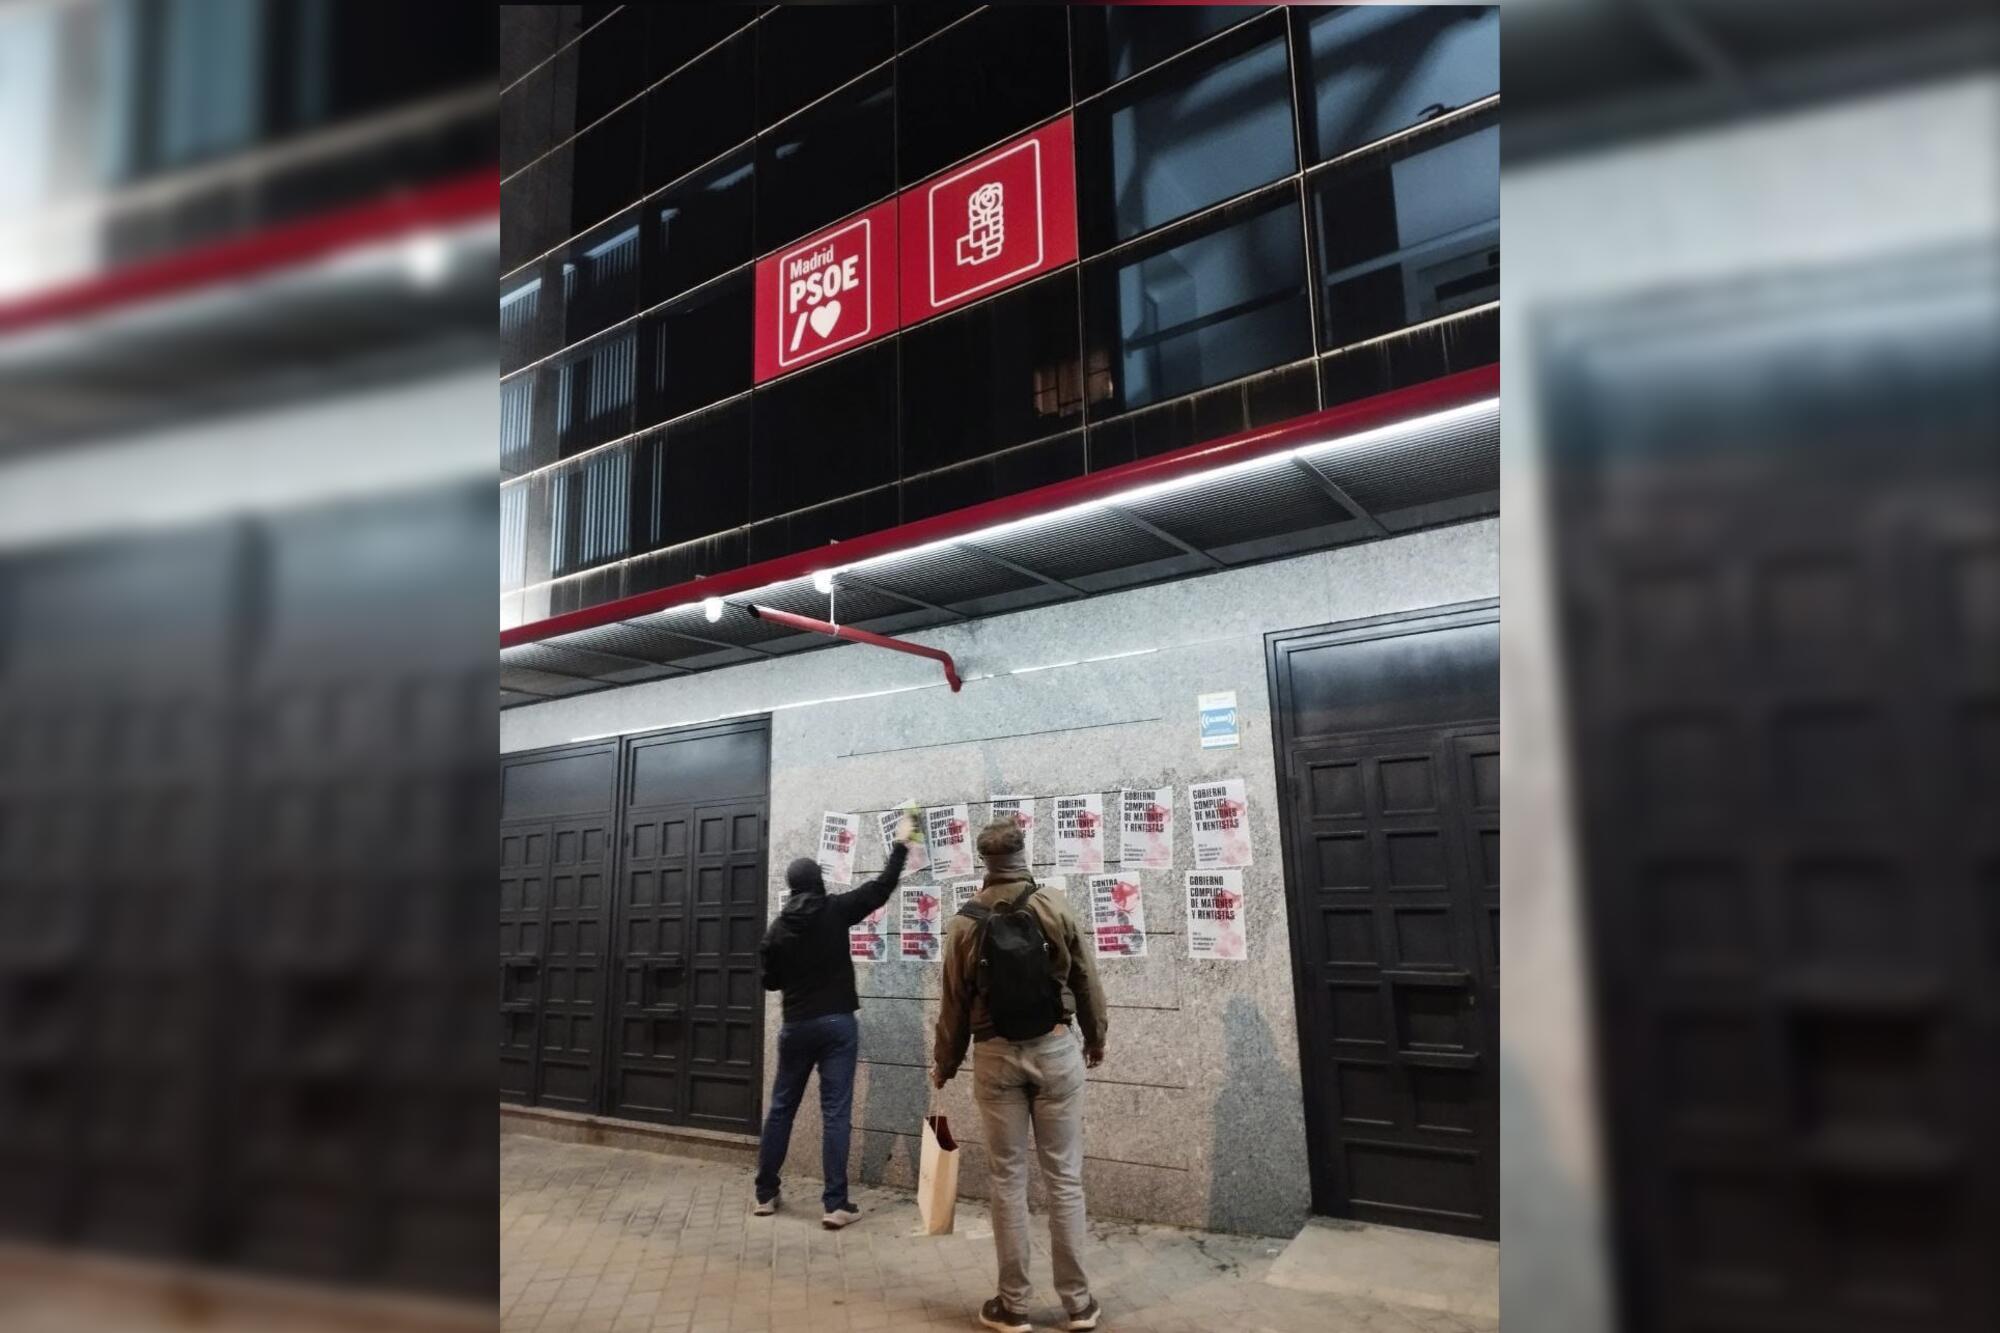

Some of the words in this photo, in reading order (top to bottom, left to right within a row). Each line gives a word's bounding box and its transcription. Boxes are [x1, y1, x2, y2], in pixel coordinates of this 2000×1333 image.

[790, 244, 834, 280] Madrid
[790, 255, 859, 314] PSOE
[1124, 791, 1155, 800] GOBIERNO
[1193, 787, 1226, 799] GOBIERNO
[1124, 813, 1131, 821] DE
[1195, 811, 1202, 820] DE
[1205, 809, 1237, 819] MATONES
[1125, 823, 1128, 832] Y
[1196, 822, 1200, 831] Y
[1203, 819, 1239, 831] RENTISTAS
[1092, 879, 1117, 887] CONTRA
[1190, 876, 1223, 886] GOBIERNO
[1191, 898, 1198, 908] DE
[1201, 898, 1233, 908] MATONES
[1192, 910, 1196, 919] Y
[1198, 910, 1235, 920] RENTISTAS
